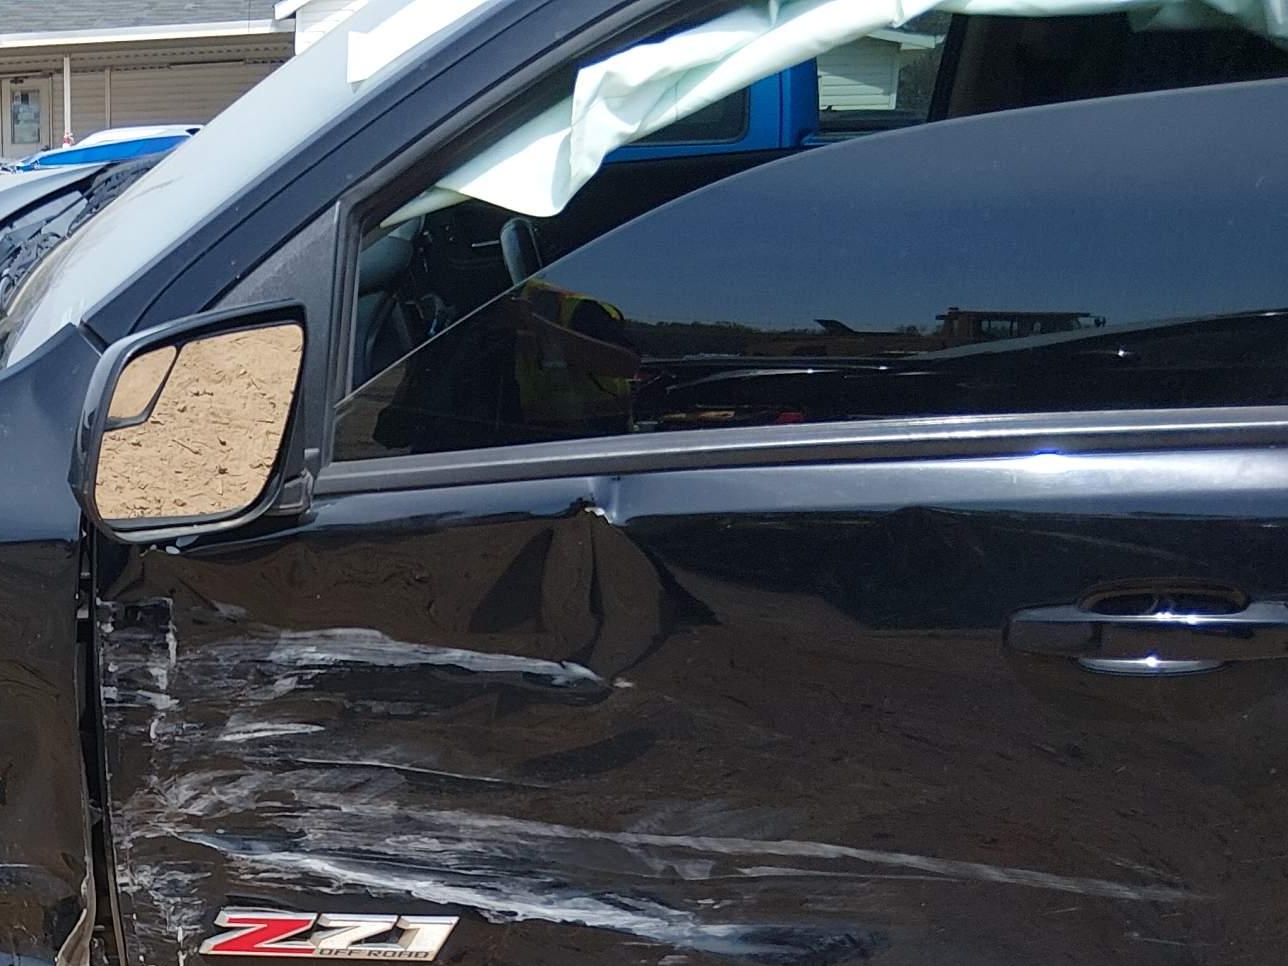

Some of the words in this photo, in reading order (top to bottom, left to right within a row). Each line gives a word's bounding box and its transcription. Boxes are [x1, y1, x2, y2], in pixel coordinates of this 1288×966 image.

[198, 906, 460, 961] Z71
[318, 948, 363, 958] OFF
[366, 949, 430, 959] ROAD
